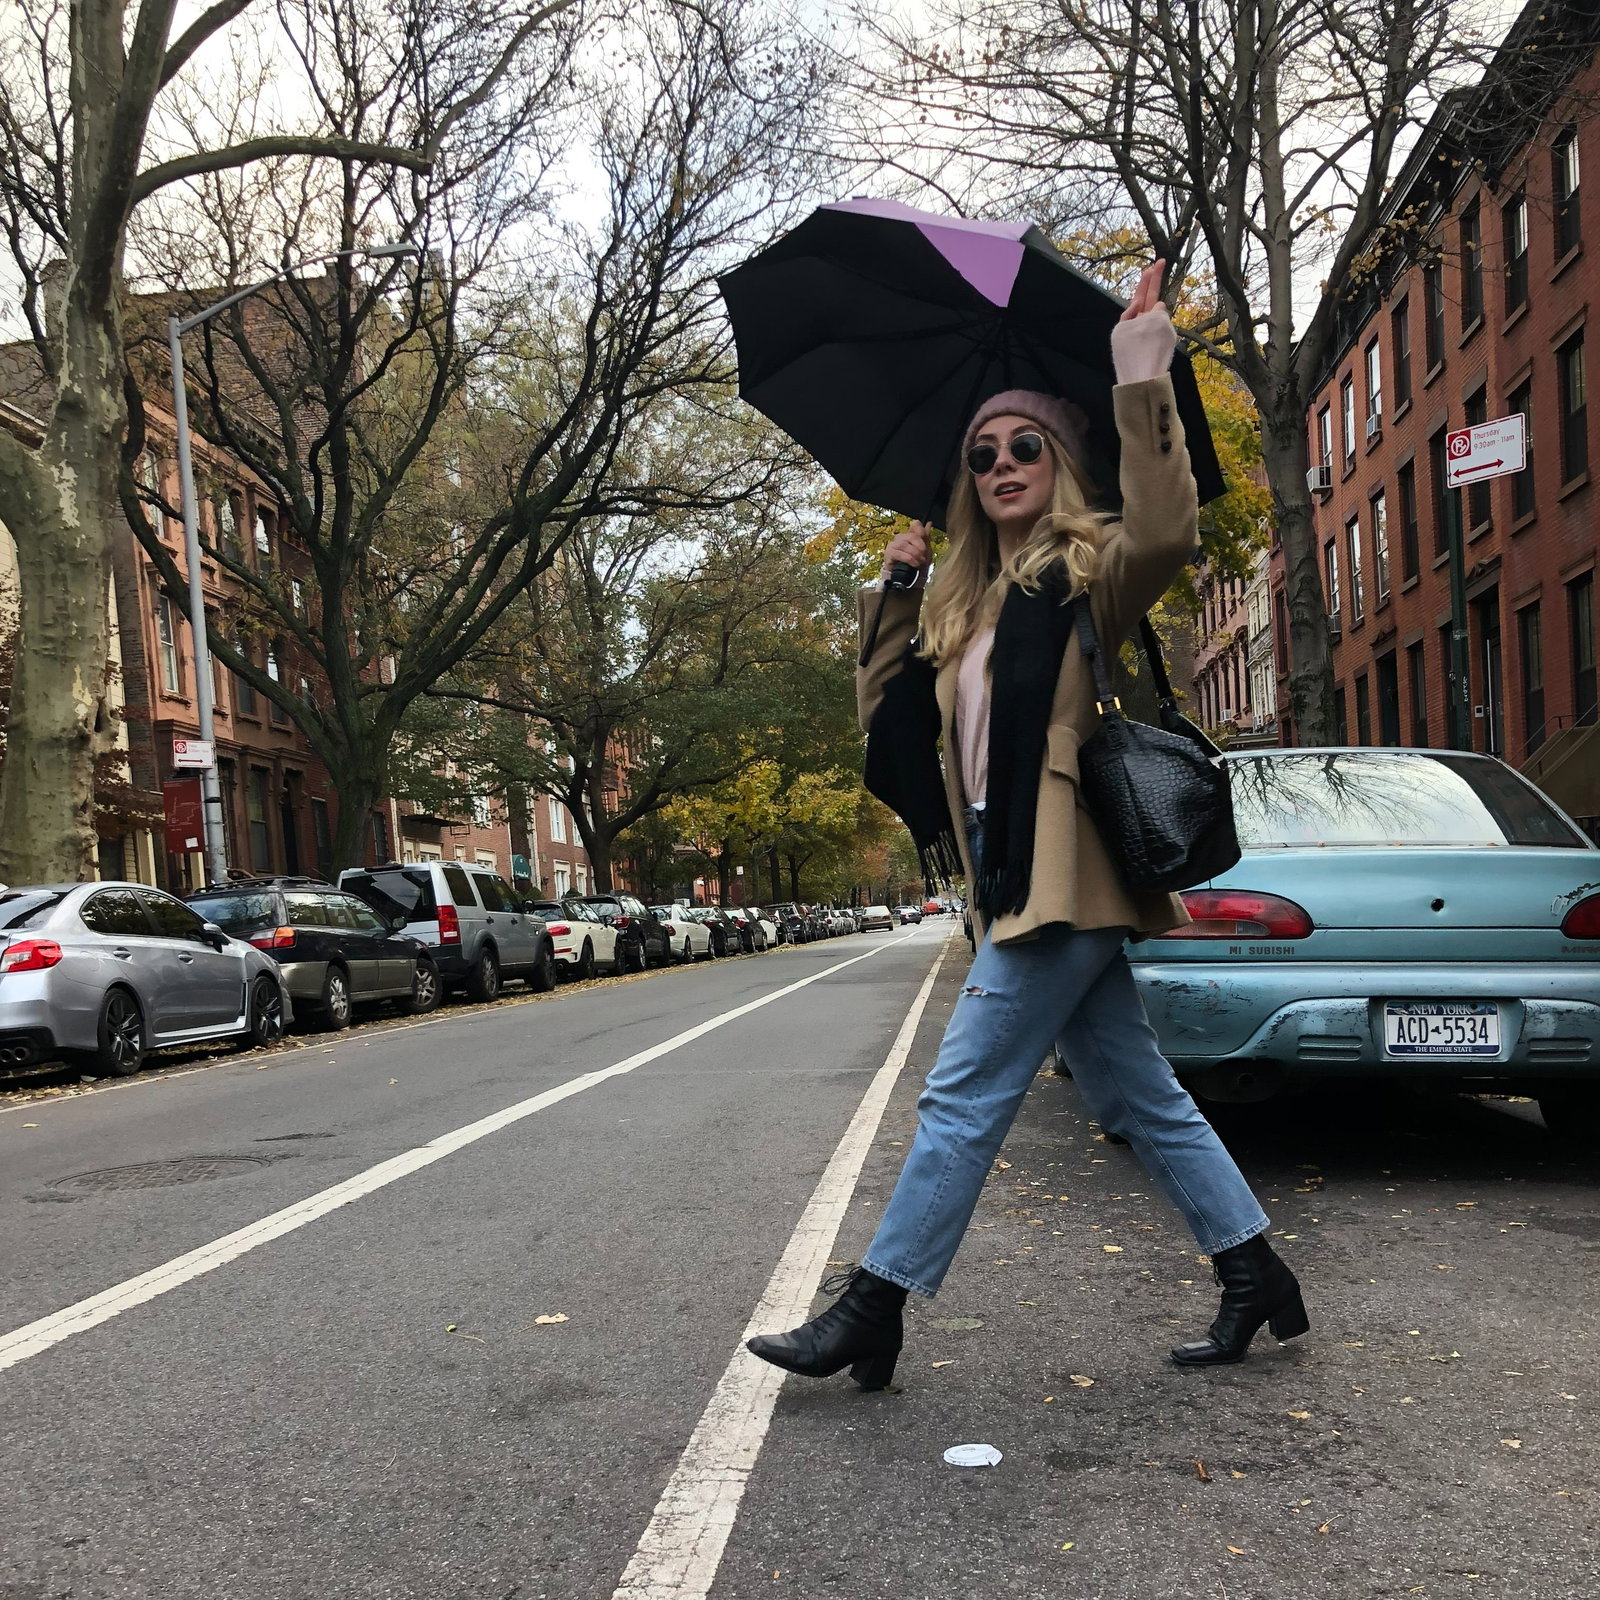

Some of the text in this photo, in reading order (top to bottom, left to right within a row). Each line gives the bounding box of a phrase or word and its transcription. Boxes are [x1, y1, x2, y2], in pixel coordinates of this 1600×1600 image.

[1474, 429, 1500, 440] Thursday
[1501, 435, 1515, 443] 11am
[1413, 1004, 1471, 1015] NEW YORK
[1442, 1017, 1489, 1045] 5534
